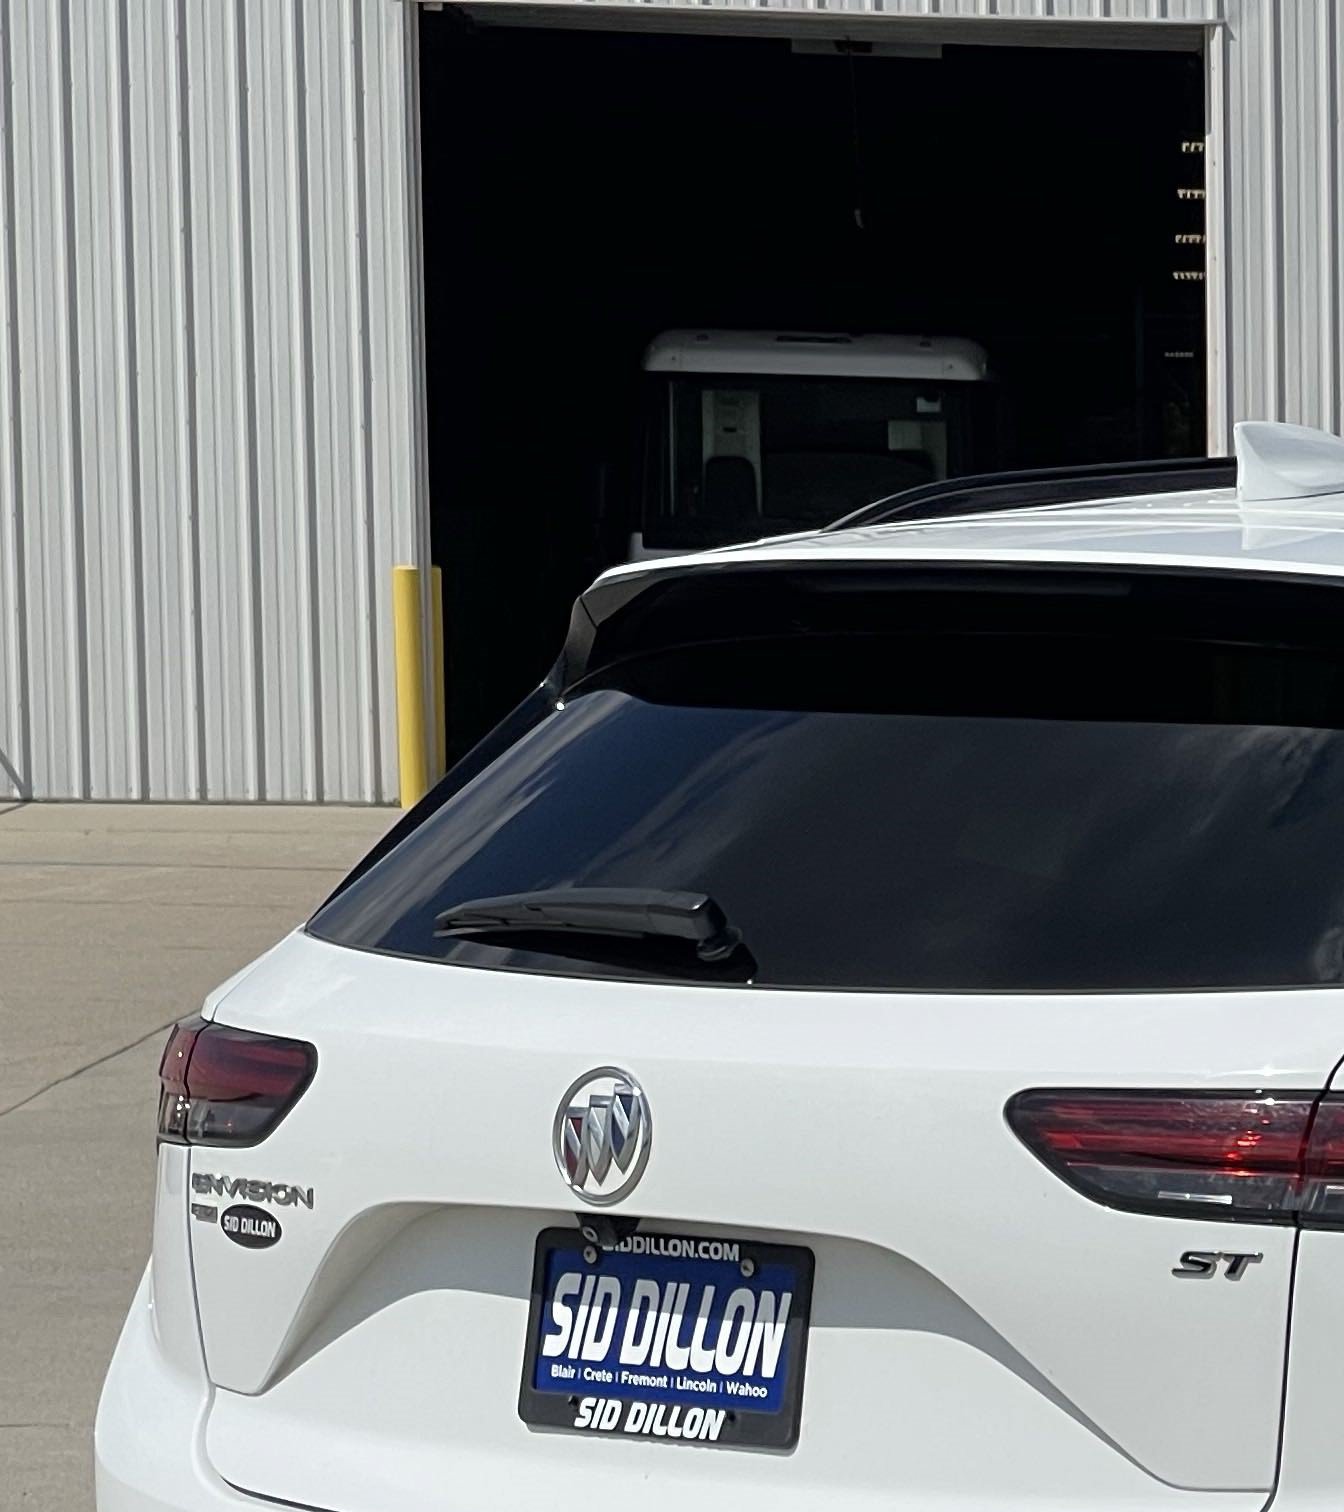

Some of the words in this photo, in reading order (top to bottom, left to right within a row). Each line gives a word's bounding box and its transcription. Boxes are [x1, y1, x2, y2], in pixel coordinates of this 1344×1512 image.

[191, 1172, 314, 1210] ENVISION
[223, 1214, 239, 1232] SID
[240, 1217, 276, 1238] DILLON
[602, 1236, 740, 1262] DDILLON.COM
[1171, 1251, 1264, 1281] ST
[542, 1272, 621, 1362] SID
[619, 1278, 793, 1379] DILLON
[551, 1364, 576, 1380] Blair
[583, 1366, 613, 1383] Crete
[621, 1371, 668, 1389] Fremont
[676, 1376, 717, 1393] Lincoln
[726, 1381, 768, 1398] Wahoo
[574, 1396, 622, 1430] SID
[624, 1401, 726, 1440] DILLON
